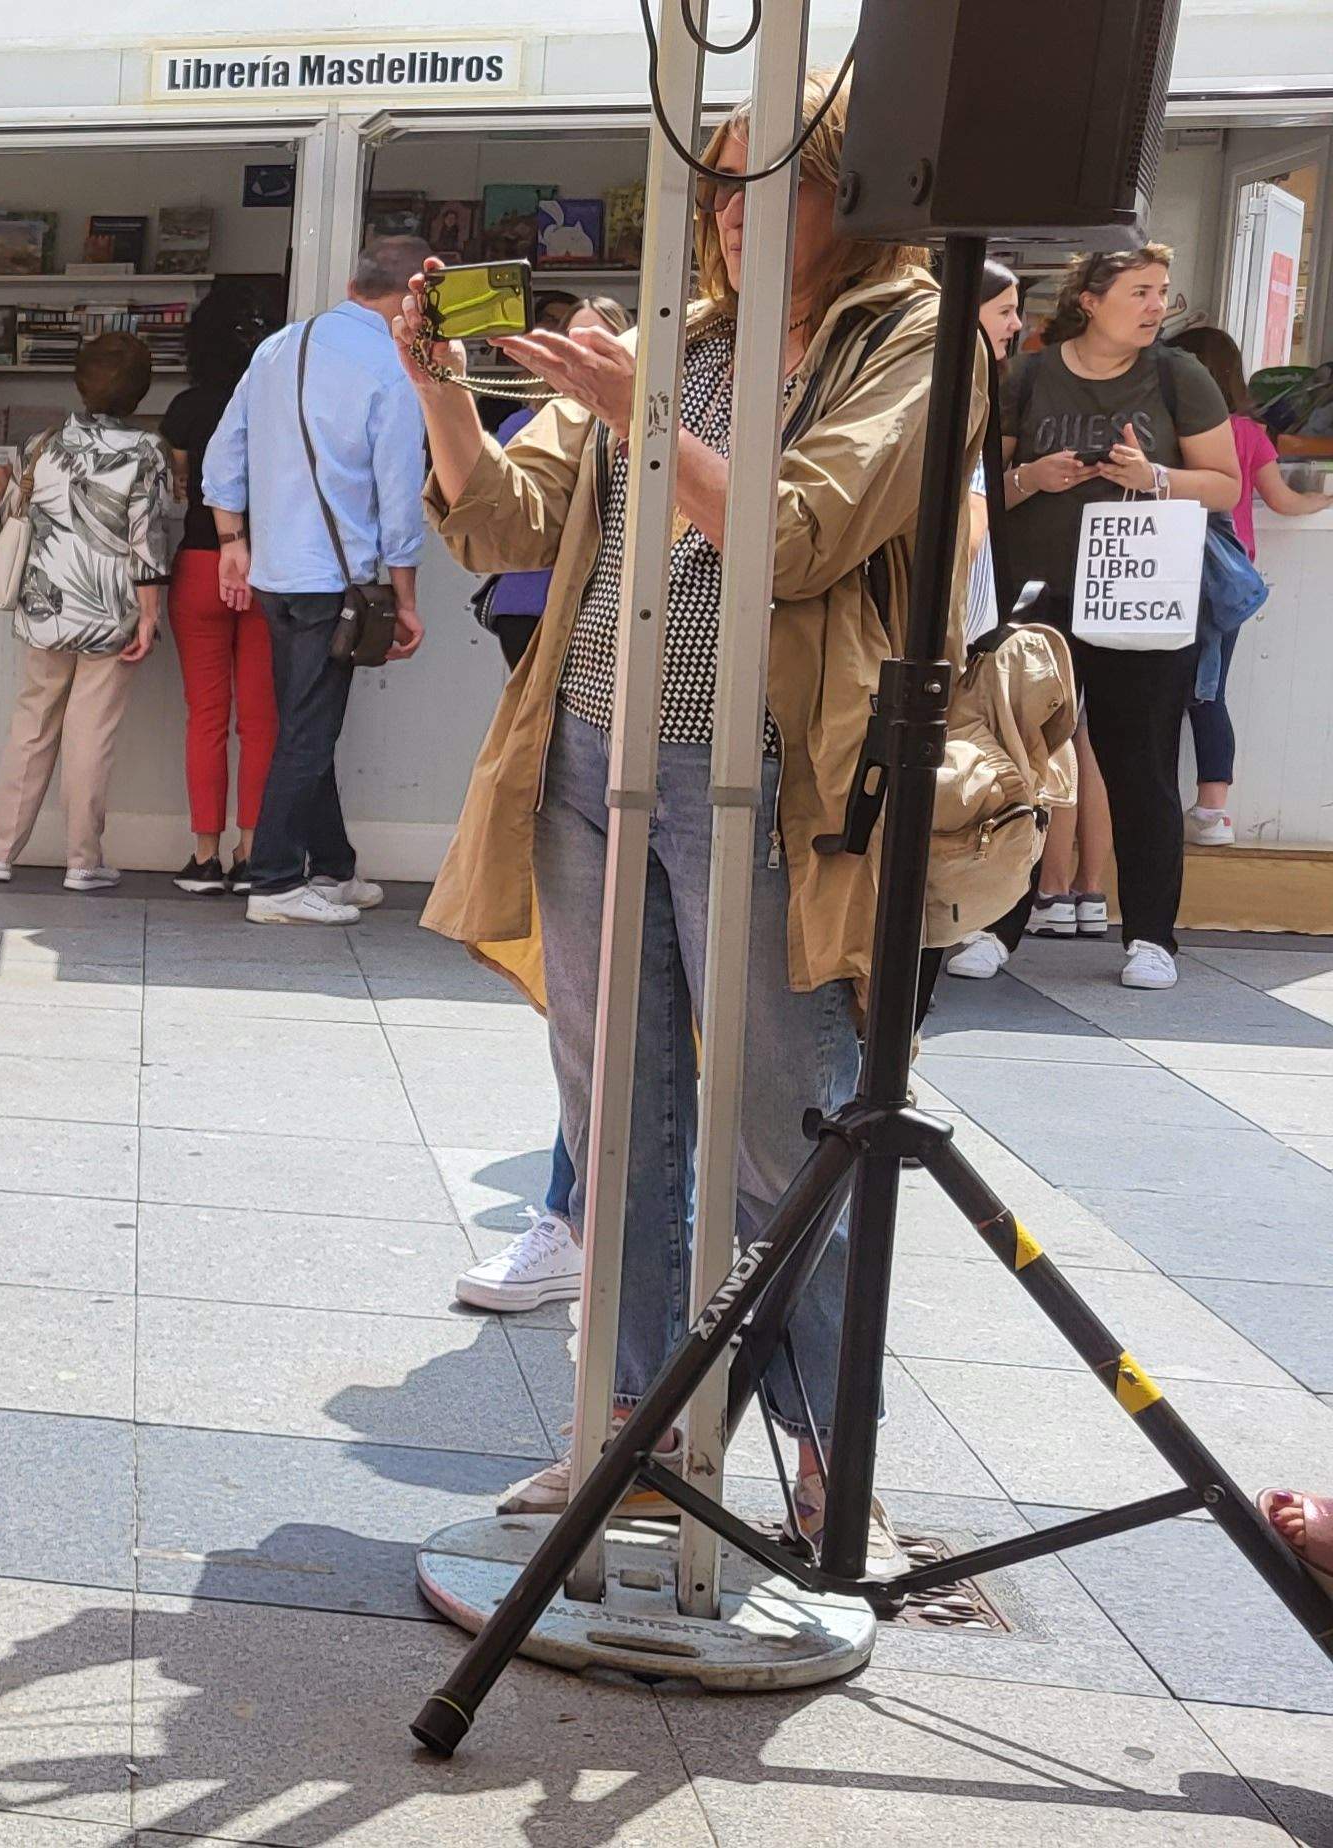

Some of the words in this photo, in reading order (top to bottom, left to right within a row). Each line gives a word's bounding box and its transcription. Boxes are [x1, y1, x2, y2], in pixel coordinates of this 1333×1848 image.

[167, 54, 290, 91] Librería
[299, 51, 503, 87] Masdelibros
[1090, 515, 1158, 537] FERIA
[1088, 538, 1131, 558] DEL
[1086, 558, 1158, 579] LIBRO
[1085, 580, 1115, 600] DE
[1083, 600, 1185, 621] HUESCA
[689, 1240, 774, 1342] VONYX
